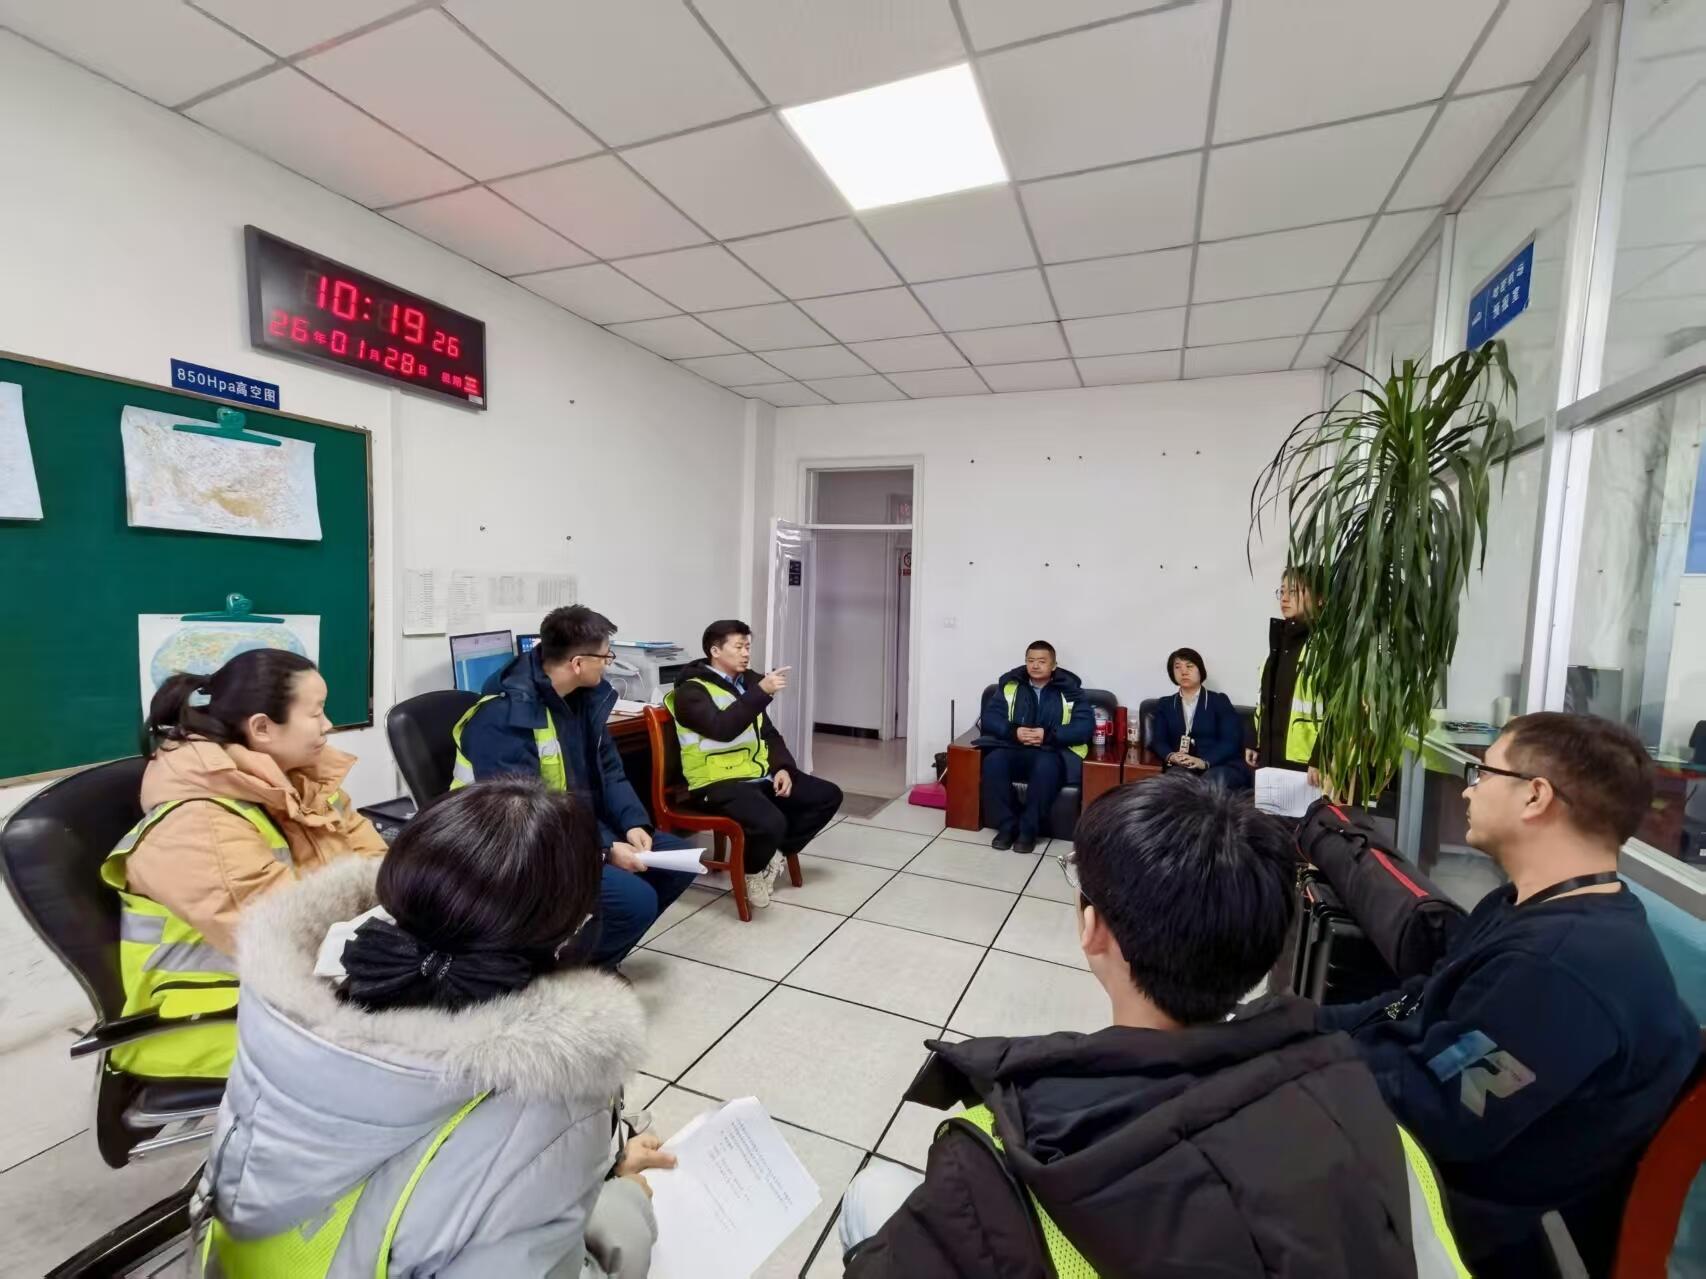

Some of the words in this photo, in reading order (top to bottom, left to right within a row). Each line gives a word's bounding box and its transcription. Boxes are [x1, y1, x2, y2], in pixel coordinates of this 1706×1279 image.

[317, 276, 425, 345] 10:19
[432, 330, 460, 358] 26
[177, 368, 276, 403] 850Hpa高空图
